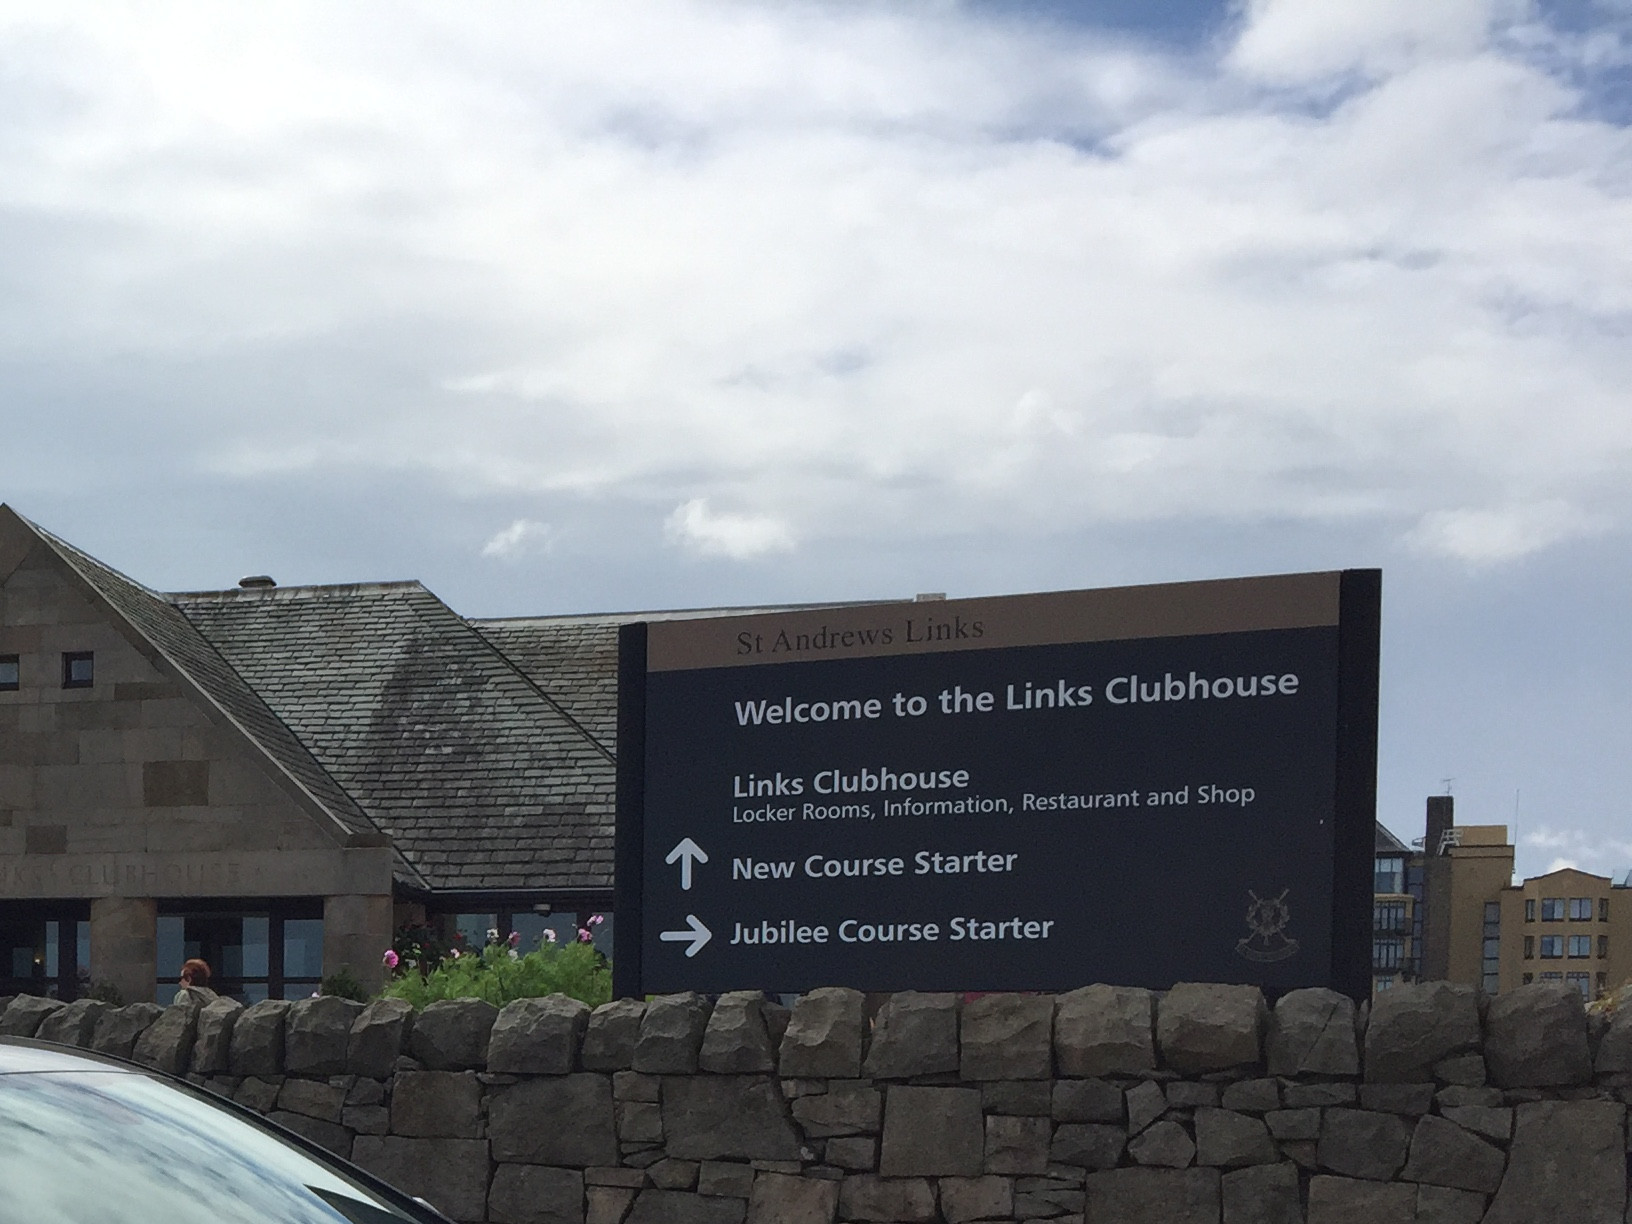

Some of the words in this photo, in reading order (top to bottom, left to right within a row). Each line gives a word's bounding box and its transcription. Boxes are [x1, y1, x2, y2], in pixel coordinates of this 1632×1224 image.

[736, 631, 763, 656] St
[771, 626, 893, 652] Andrews
[905, 616, 985, 643] Links
[734, 697, 882, 726] Welcome
[891, 692, 928, 717] to
[938, 686, 995, 714] the
[1006, 680, 1093, 710] Links
[1105, 671, 1299, 704] Clubhouse
[733, 772, 804, 798] Links
[813, 766, 970, 794] Clubhouse
[732, 803, 797, 823] Locker
[802, 803, 876, 820] Rooms,
[884, 796, 1014, 817] Information,
[1022, 789, 1140, 811] Restaurant
[1146, 785, 1189, 806] and
[1197, 784, 1256, 807] Shop
[732, 857, 796, 880] New
[804, 854, 905, 878] Course
[914, 850, 1019, 875] Starter
[729, 919, 830, 945] Jubilee
[838, 919, 940, 943] Course
[949, 916, 1055, 941] Starter
